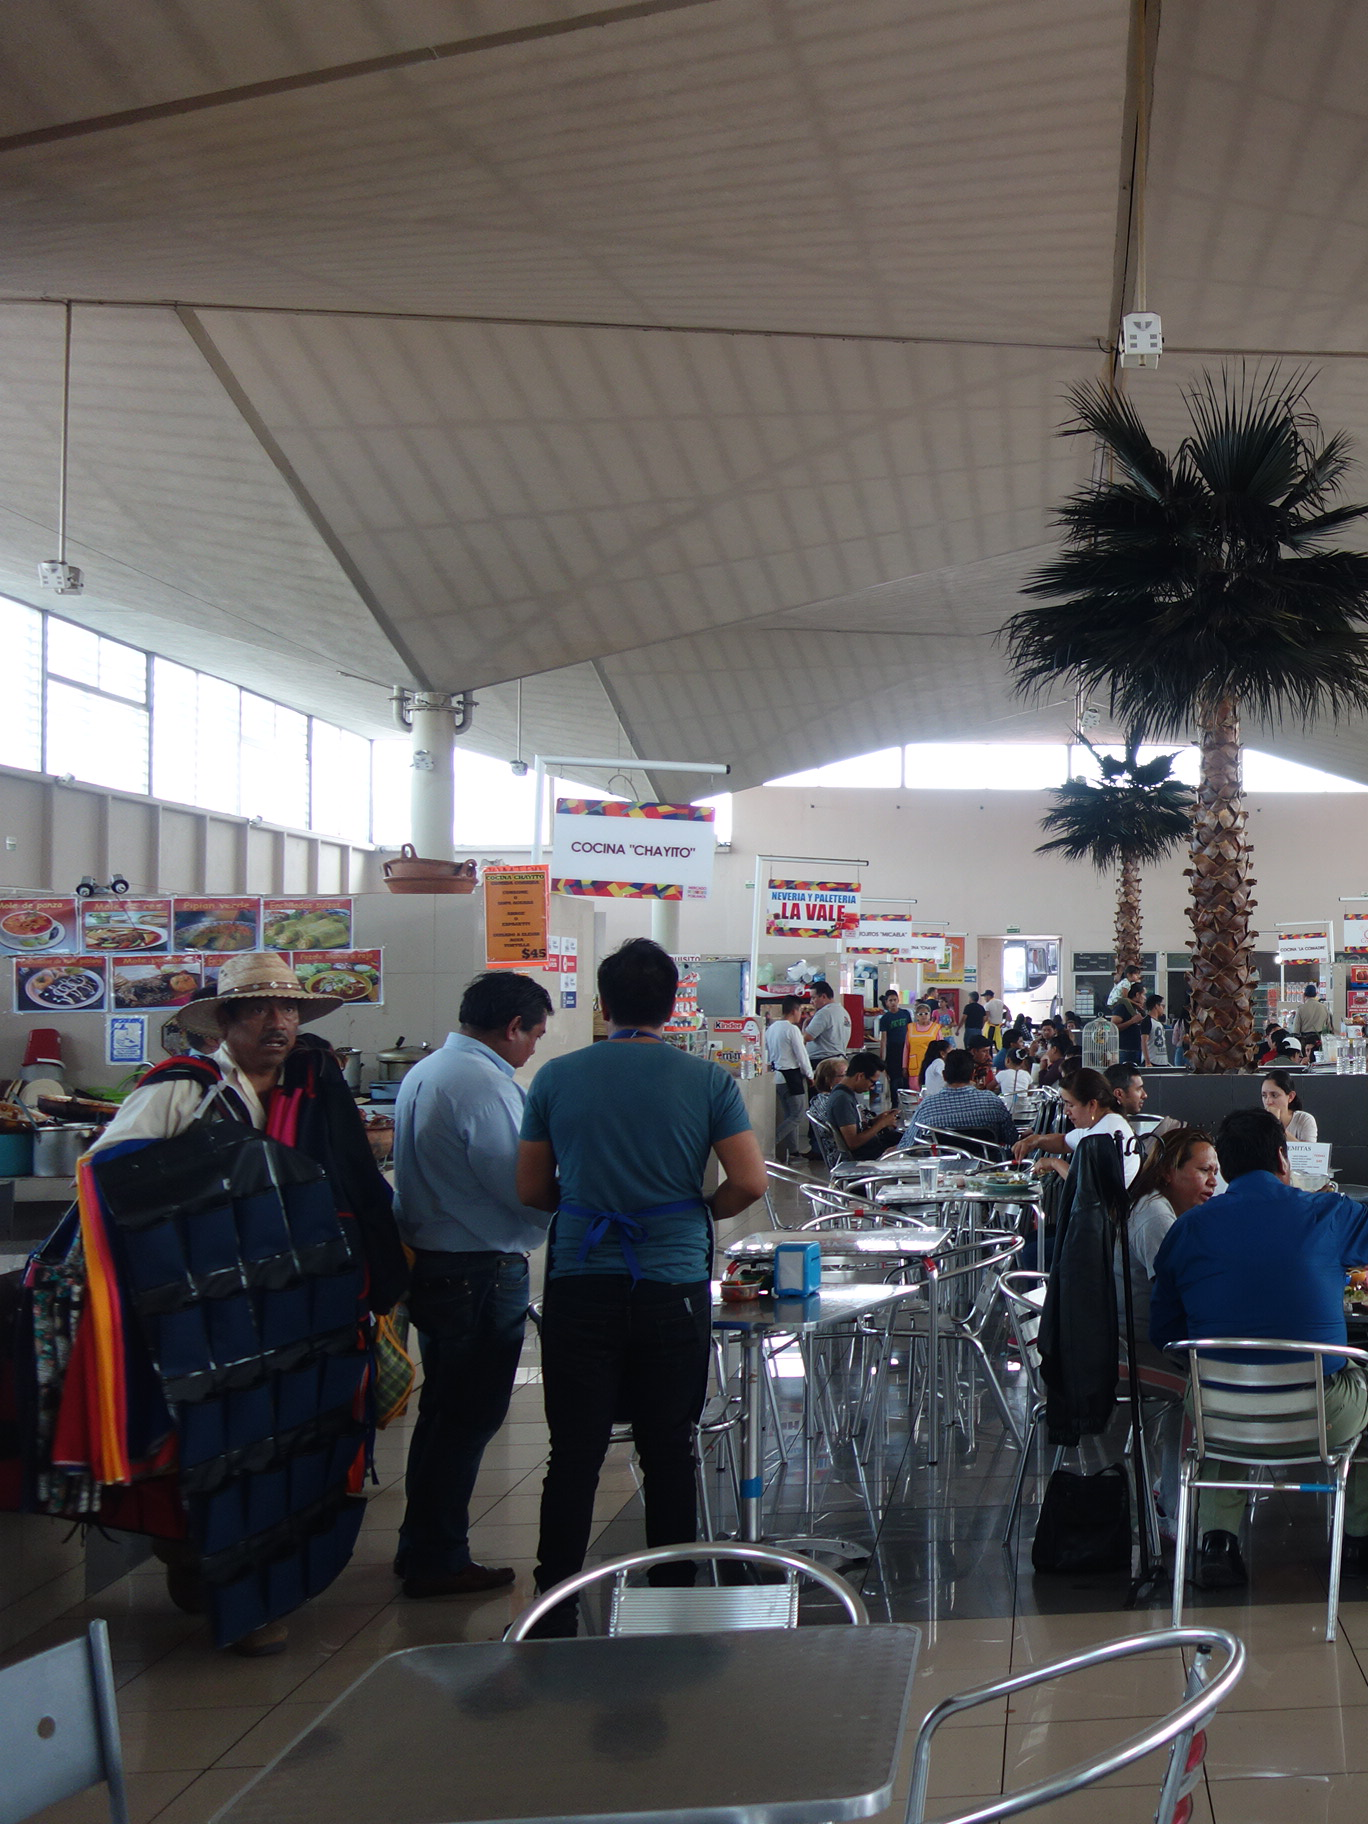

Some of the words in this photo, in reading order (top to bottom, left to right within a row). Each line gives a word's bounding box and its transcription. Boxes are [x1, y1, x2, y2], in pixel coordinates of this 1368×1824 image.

[571, 841, 626, 855] COCINA
[629, 844, 696, 858] "CHAYITO"
[772, 891, 806, 902] NEVERIA
[807, 893, 812, 902] Y
[814, 894, 856, 904] PALETERIA
[36, 902, 63, 911] panza
[95, 903, 121, 911] Mole
[269, 901, 313, 909] Enchiladas
[781, 902, 801, 920] LA
[805, 903, 846, 922] VALE
[521, 948, 546, 959] $45
[715, 1021, 743, 1029] Kinder
